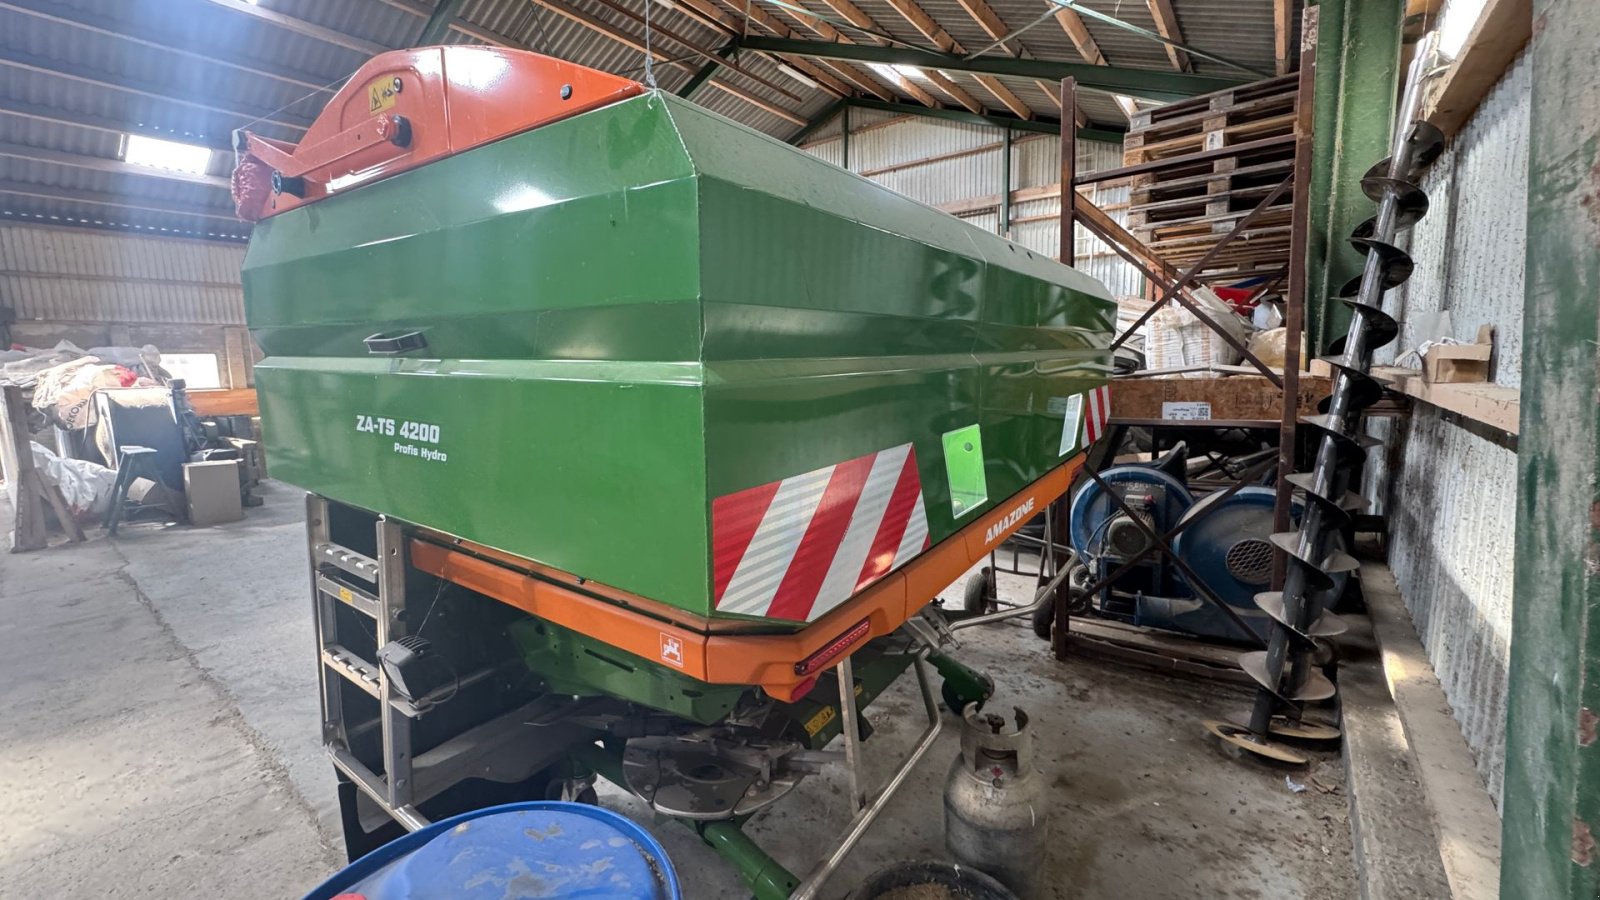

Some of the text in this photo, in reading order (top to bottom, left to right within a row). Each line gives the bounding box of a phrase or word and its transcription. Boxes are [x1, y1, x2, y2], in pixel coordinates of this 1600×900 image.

[356, 414, 440, 444] ZA-TS 4200
[394, 442, 447, 462] Profis Hydro
[984, 496, 1035, 545] AMAZONE
